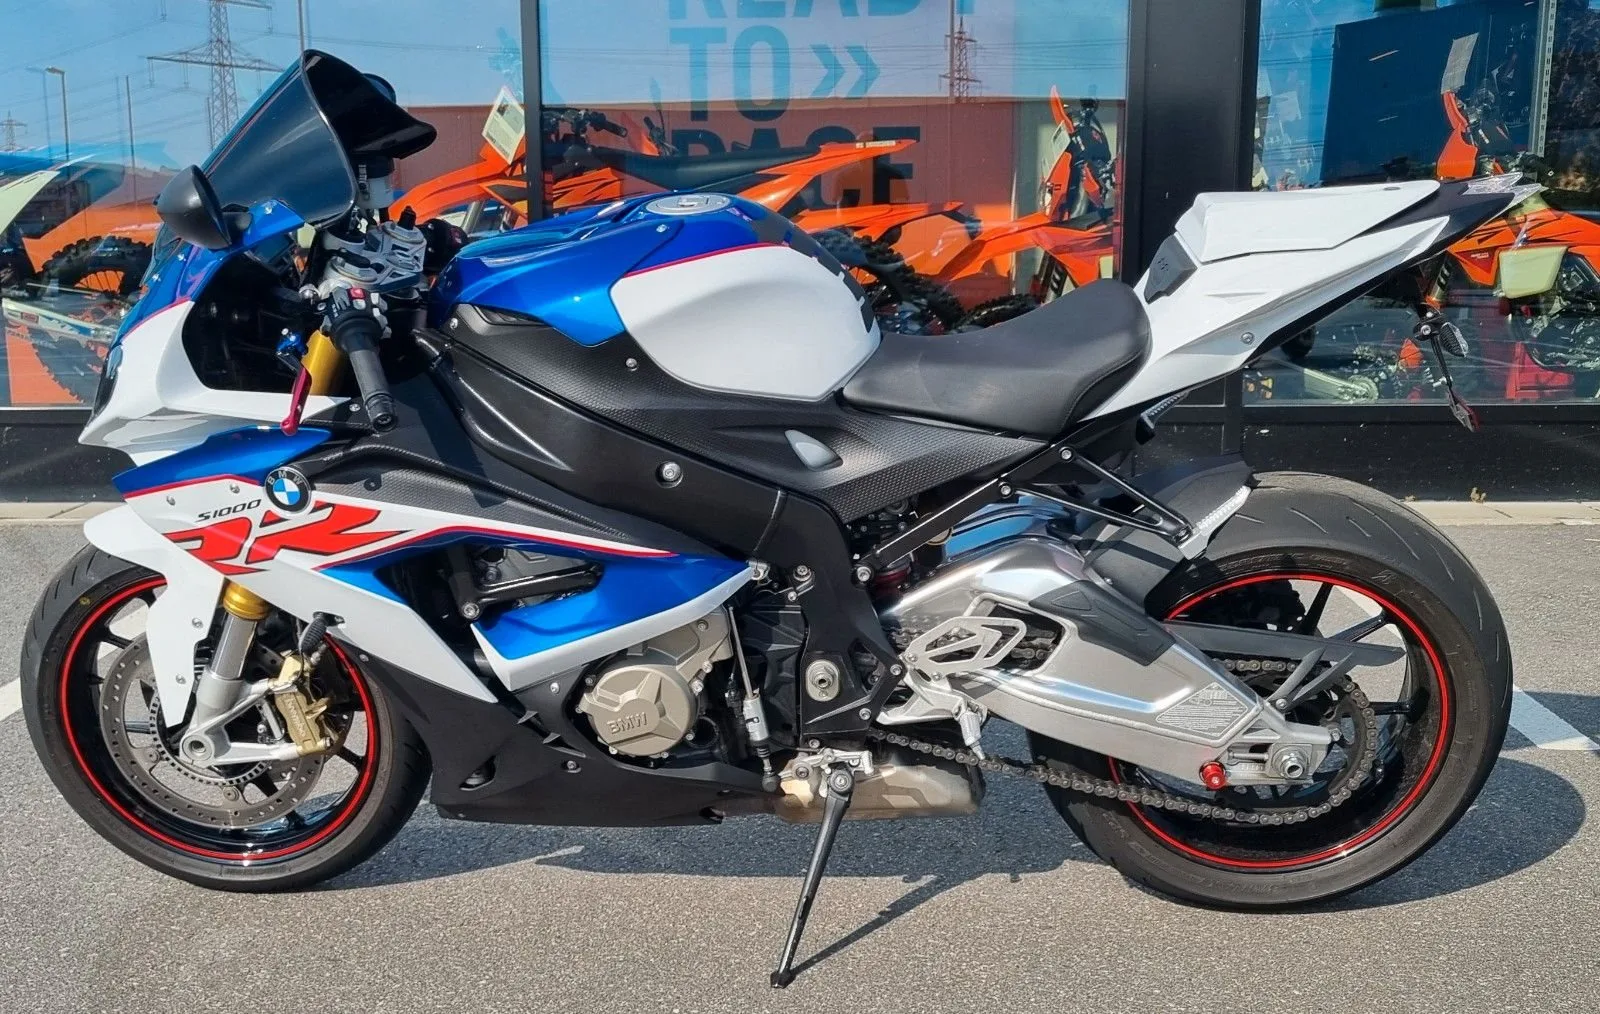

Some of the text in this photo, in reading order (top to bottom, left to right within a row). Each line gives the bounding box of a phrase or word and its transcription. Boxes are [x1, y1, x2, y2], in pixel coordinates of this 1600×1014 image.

[669, 25, 790, 122] TO
[196, 499, 262, 522] S1000
[606, 711, 648, 734] BMW
